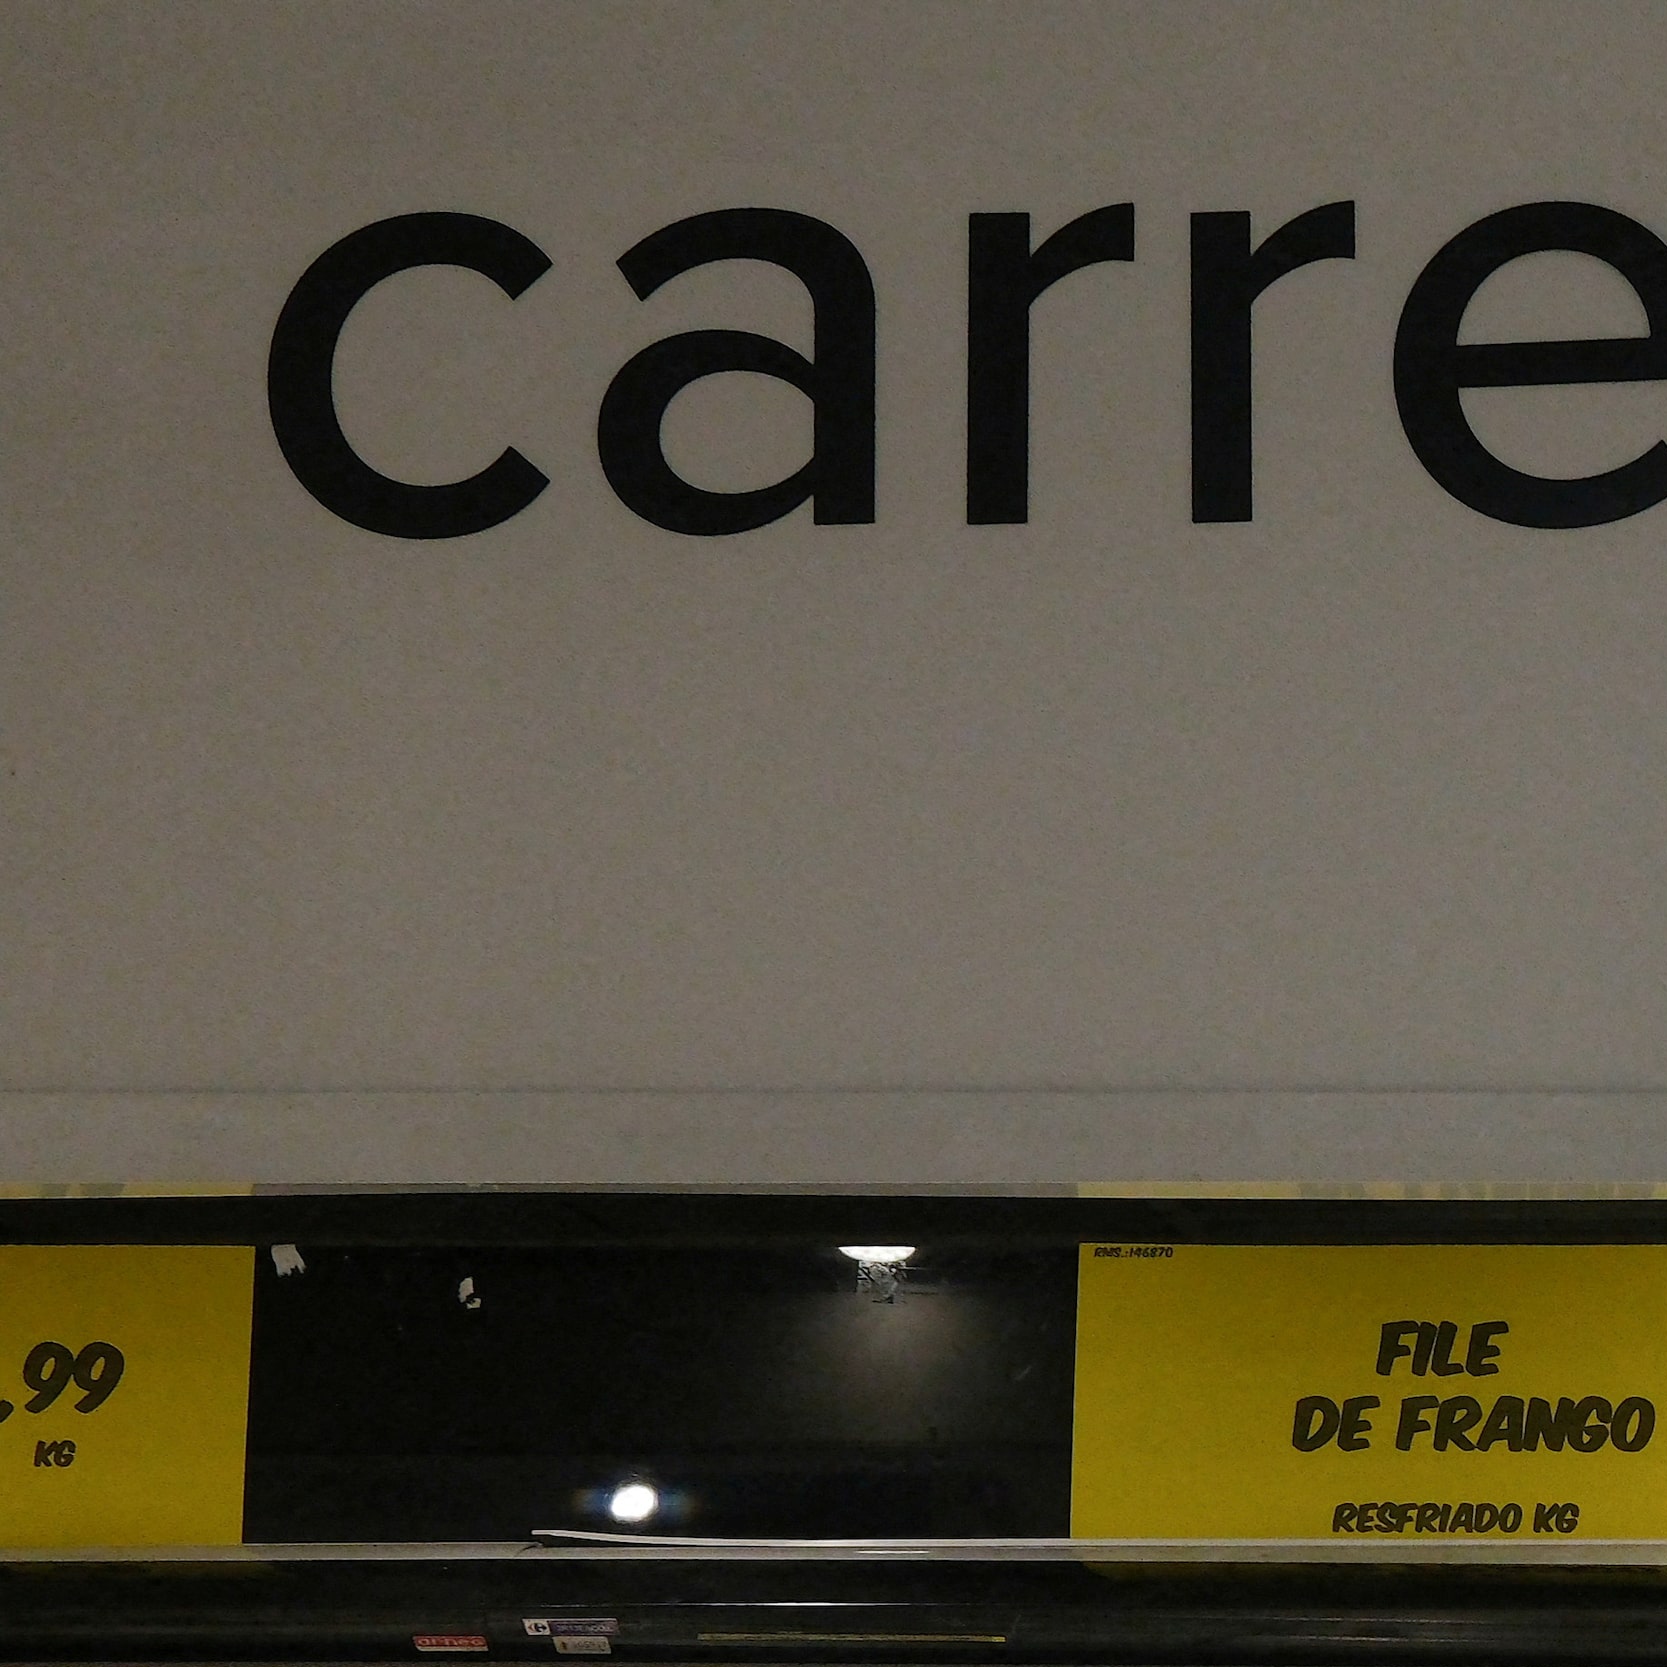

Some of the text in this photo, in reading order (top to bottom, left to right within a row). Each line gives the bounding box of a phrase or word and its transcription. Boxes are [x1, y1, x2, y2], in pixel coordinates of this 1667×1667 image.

[1375, 1320, 1510, 1377] FILE
[1291, 1394, 1656, 1455] DE FRANGO
[33, 1439, 77, 1471] KG
[1330, 1500, 1580, 1535] RESFRIADO KG
